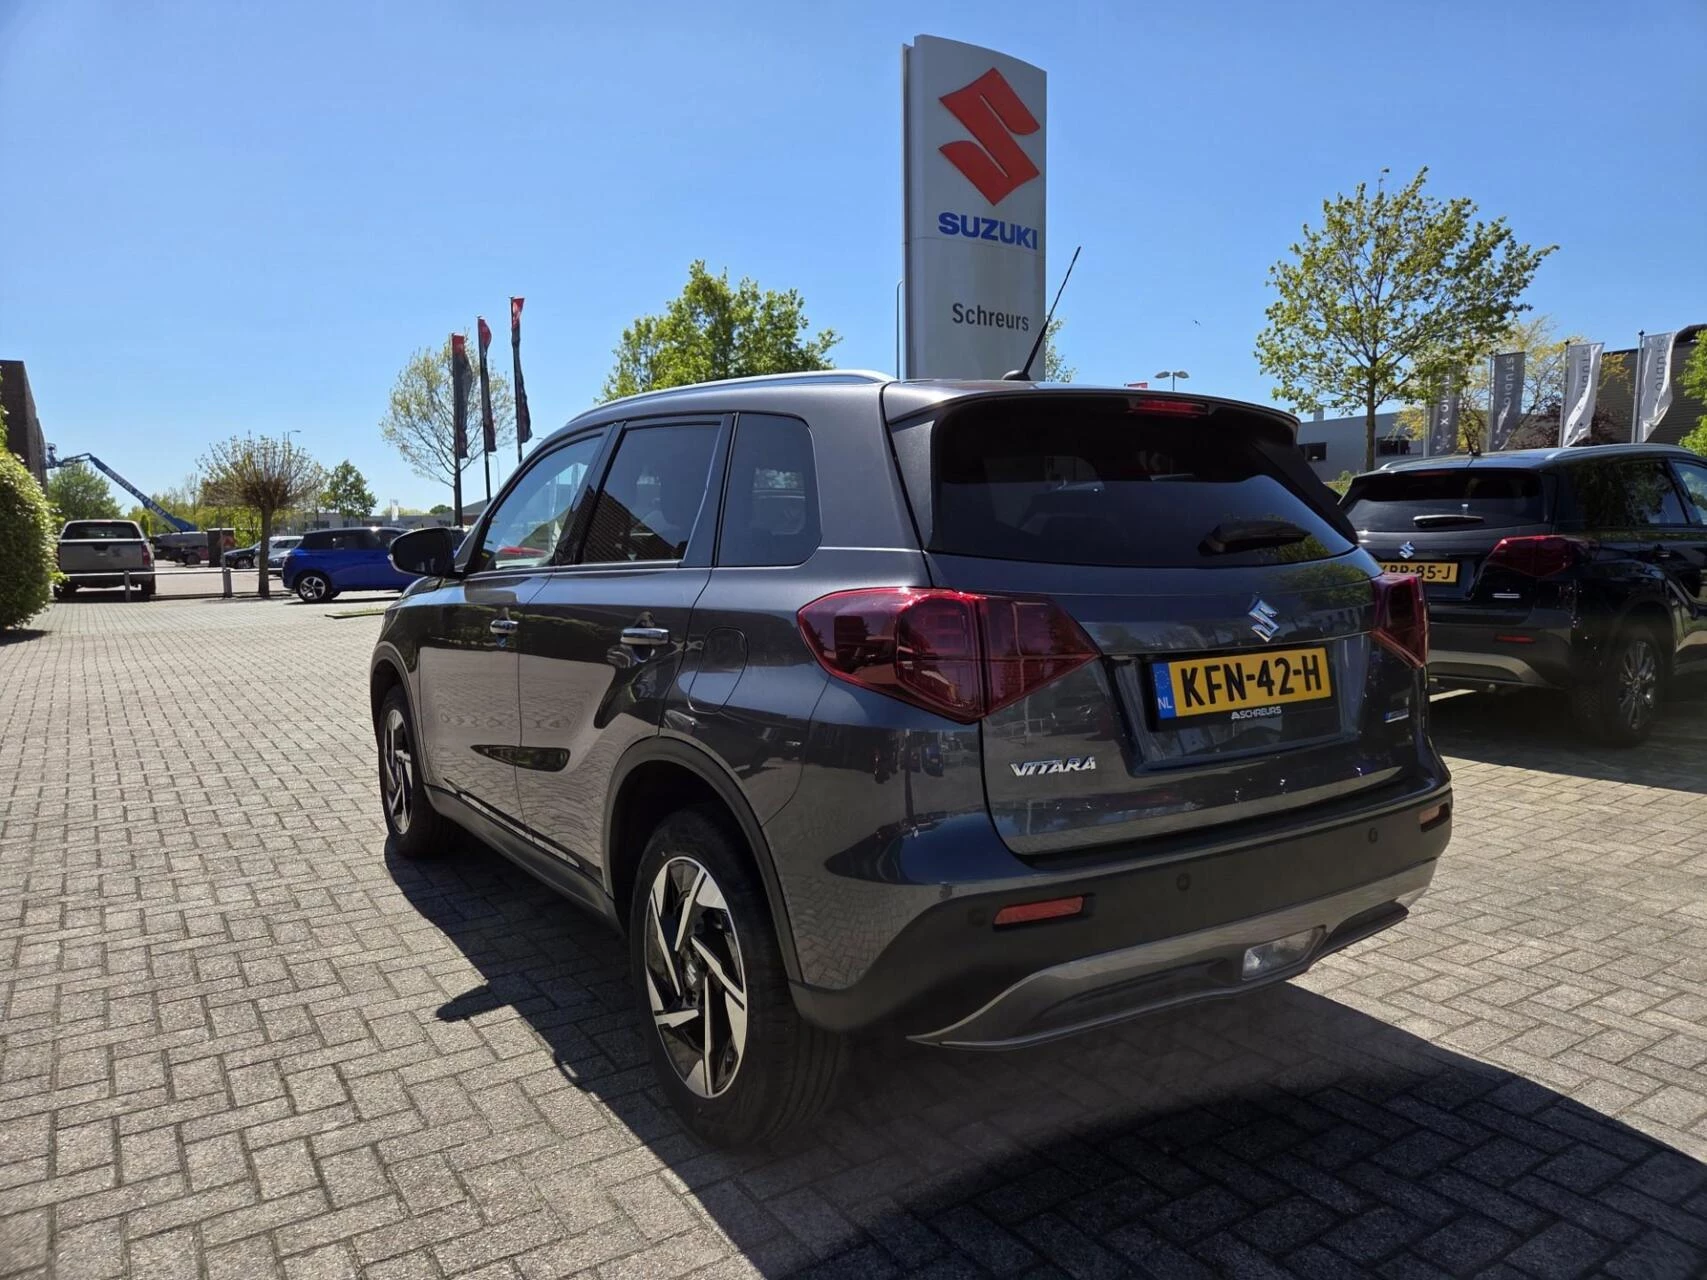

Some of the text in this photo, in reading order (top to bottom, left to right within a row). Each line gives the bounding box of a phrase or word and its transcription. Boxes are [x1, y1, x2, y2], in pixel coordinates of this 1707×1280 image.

[938, 212, 1037, 250] SUZUKI
[952, 302, 1029, 332] Schreurs
[1504, 355, 1514, 405] STUDIO
[1382, 564, 1452, 580] -85-J
[1180, 654, 1322, 708] KFN-42-H
[1157, 697, 1174, 710] NL
[1010, 756, 1096, 777] VITARA
